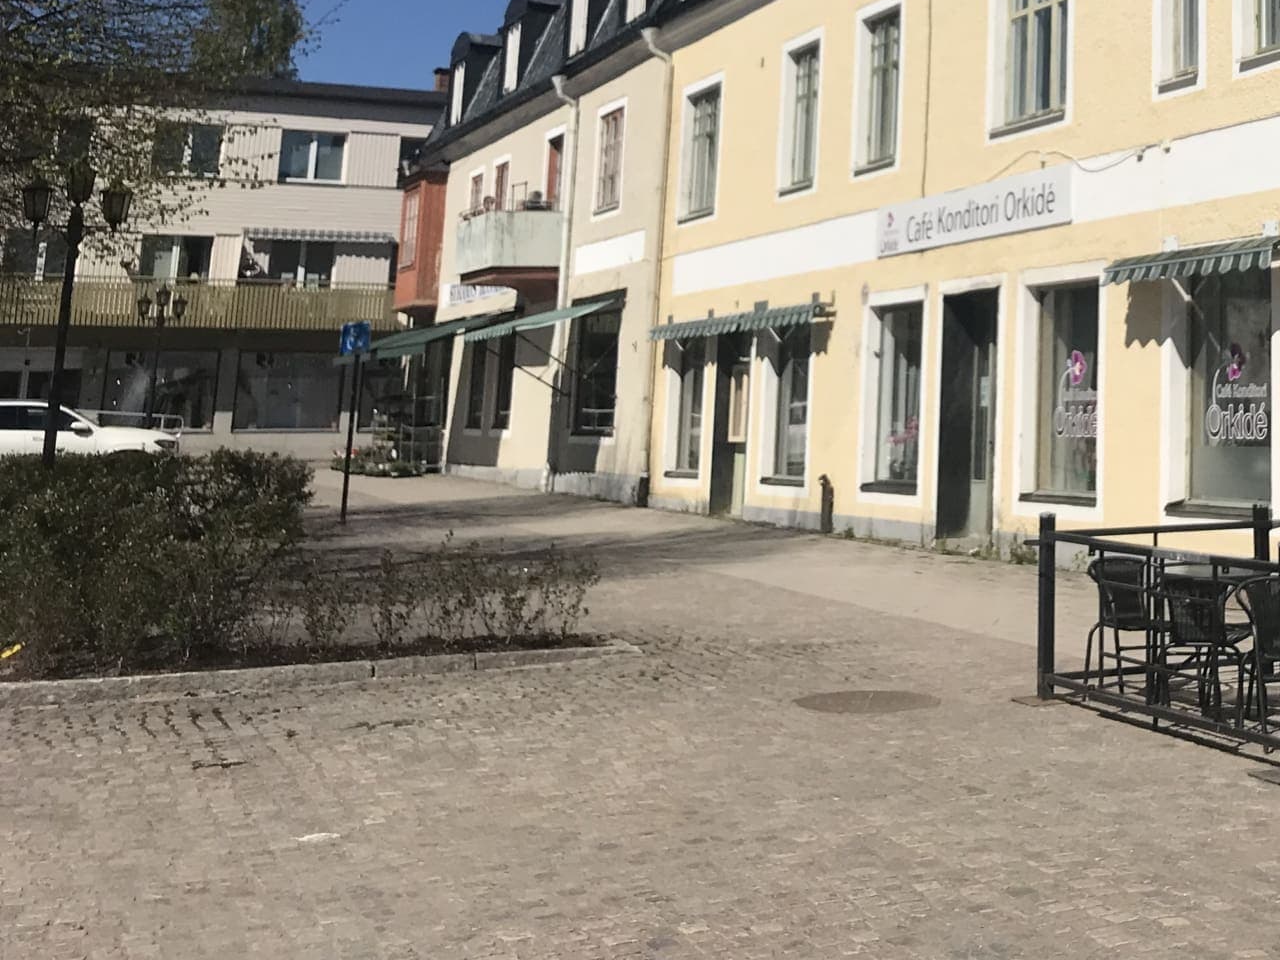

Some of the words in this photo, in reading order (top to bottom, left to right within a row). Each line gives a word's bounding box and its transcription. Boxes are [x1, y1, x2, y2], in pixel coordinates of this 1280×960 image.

[906, 211, 933, 244] Café
[937, 195, 999, 235] Konditori
[1003, 182, 1056, 222] Orkidé
[1206, 401, 1268, 440] Orkidé
